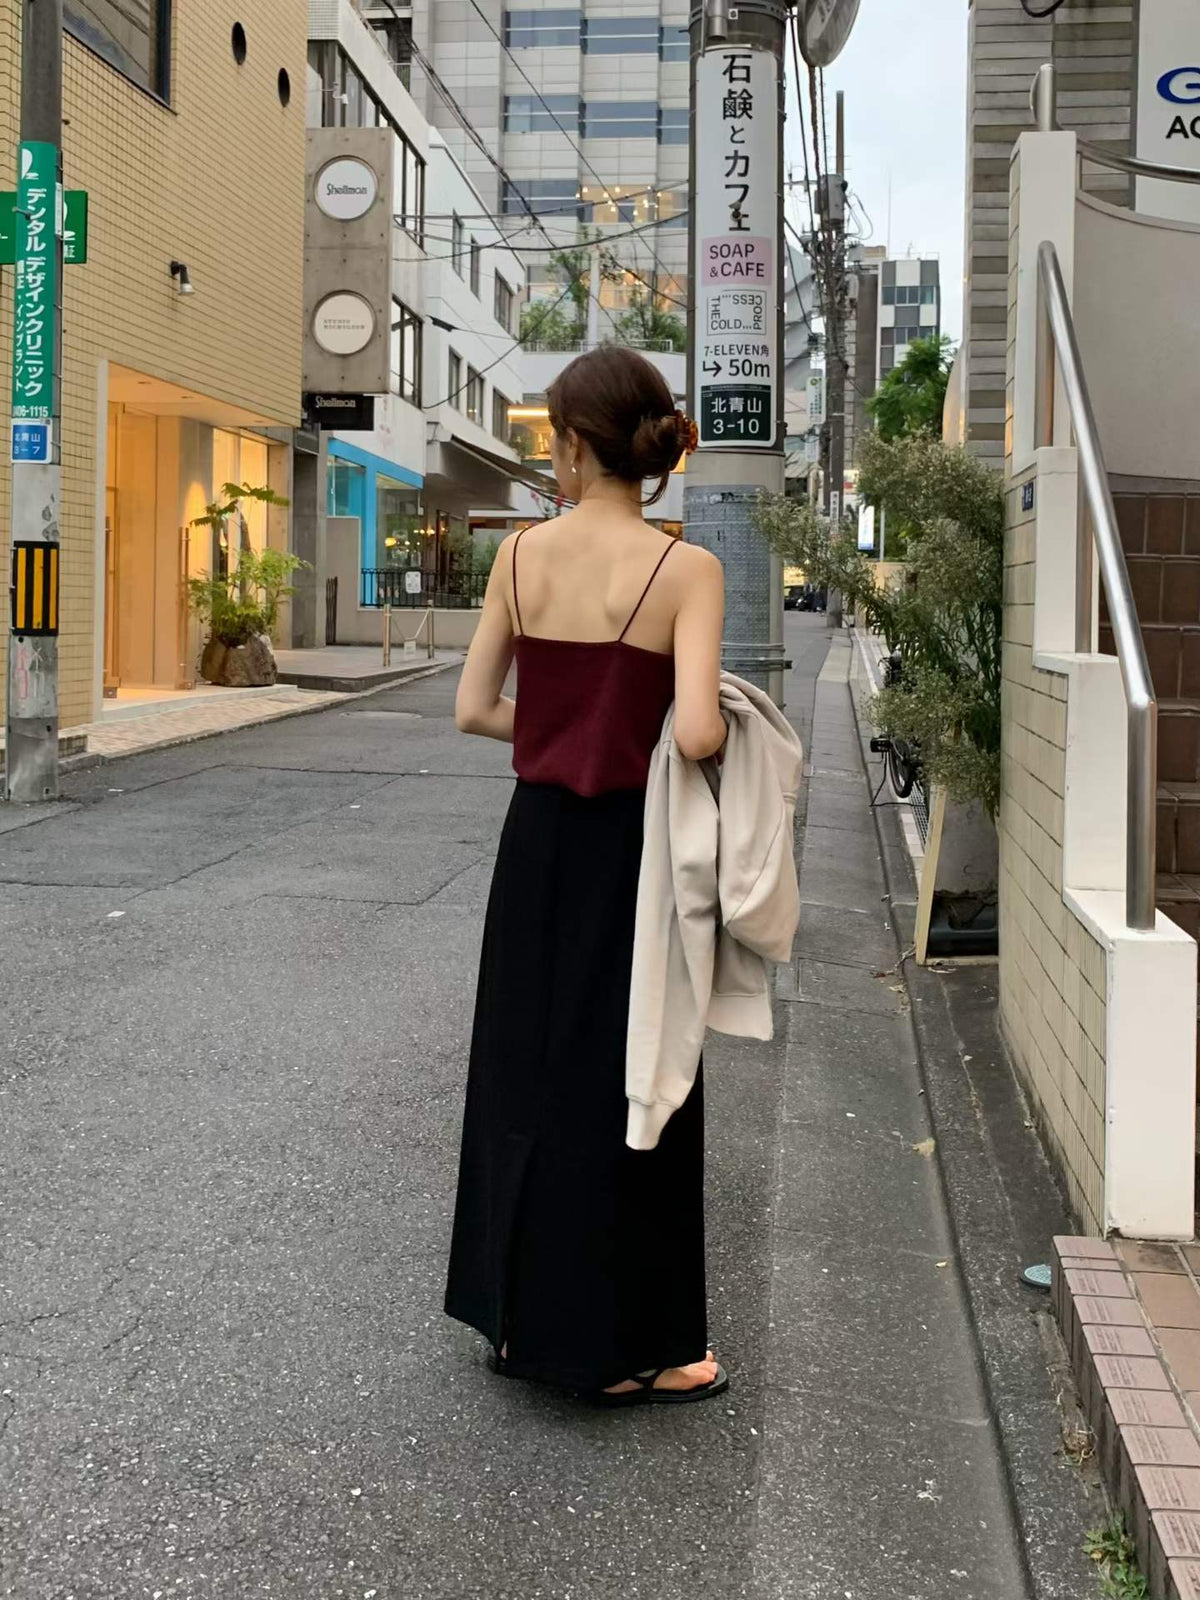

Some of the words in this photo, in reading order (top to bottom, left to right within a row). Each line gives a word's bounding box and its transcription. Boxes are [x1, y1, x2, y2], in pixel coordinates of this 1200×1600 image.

[722, 54, 753, 231] 石鹸とカフェ
[25, 188, 47, 252] デンタル
[709, 243, 755, 260] SOAP
[710, 295, 721, 319] THE
[24, 256, 47, 397] デザインクリニック
[728, 359, 770, 378] 50m
[711, 397, 762, 413] 北青山
[713, 419, 760, 434] 3-10
